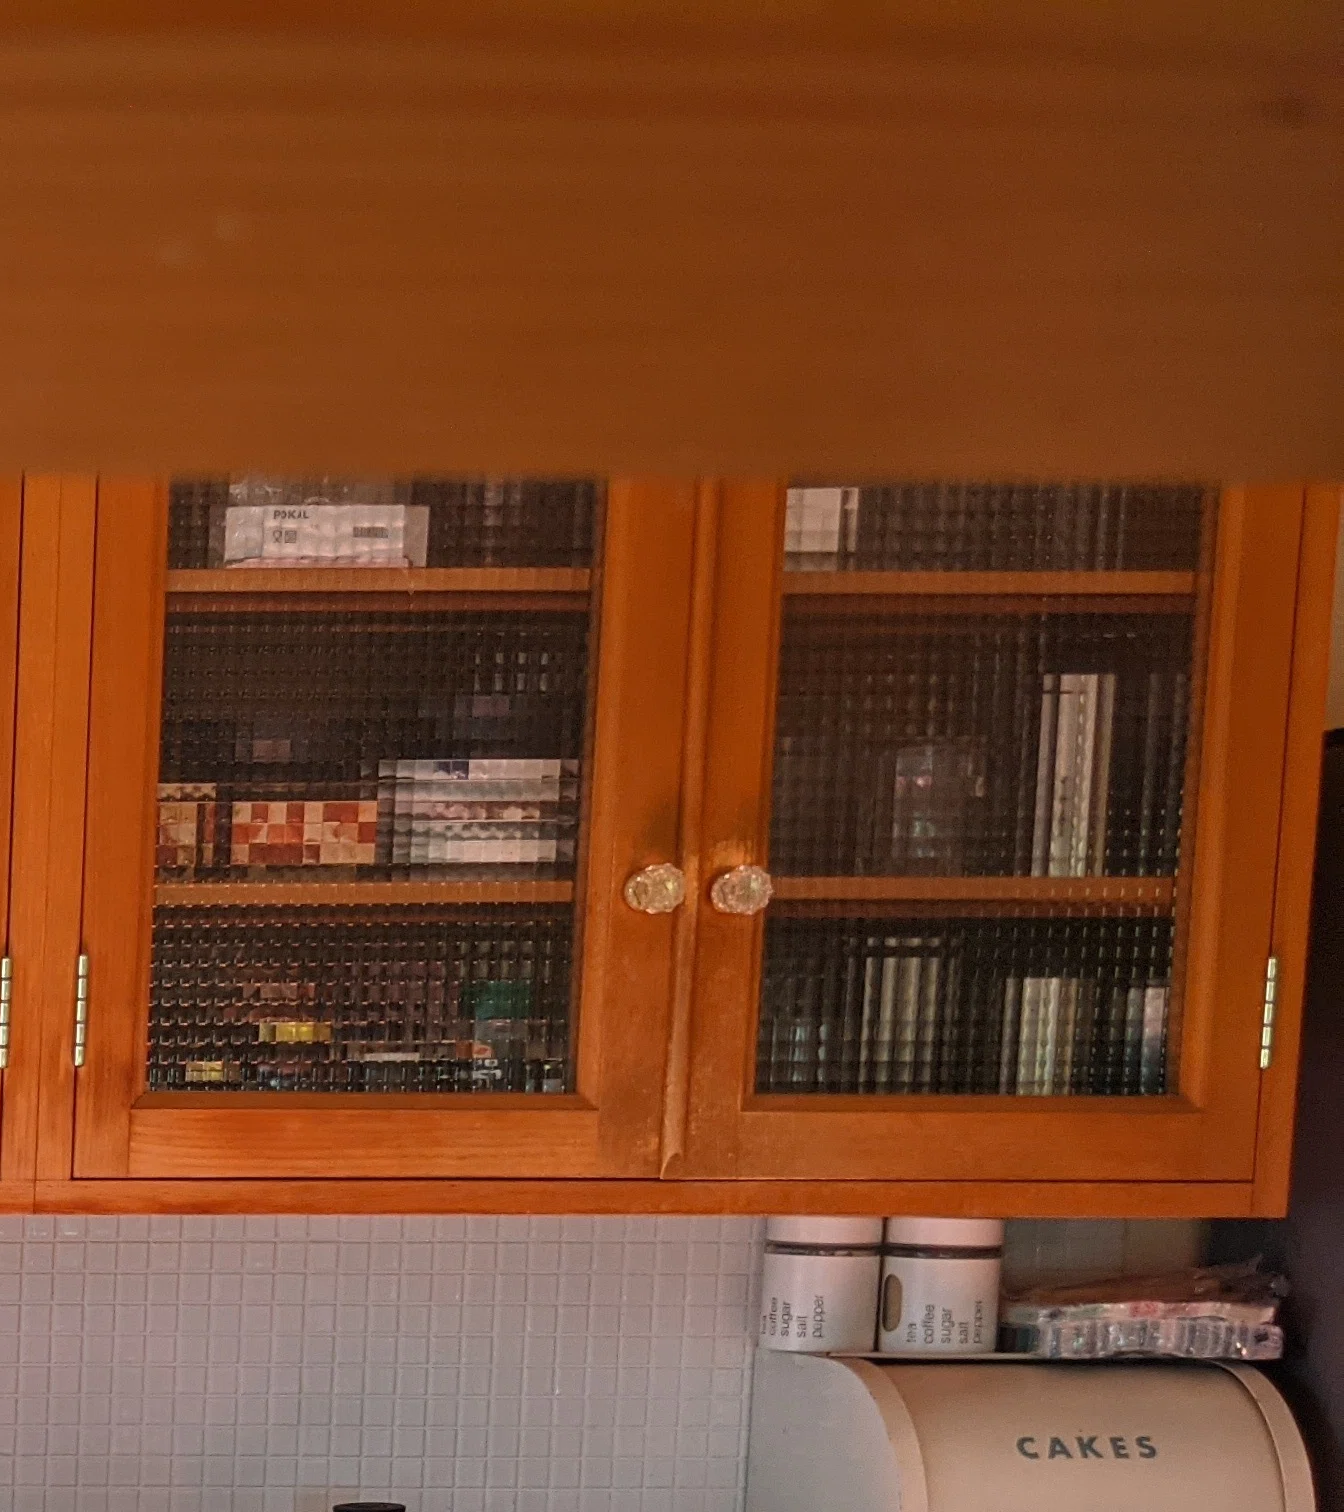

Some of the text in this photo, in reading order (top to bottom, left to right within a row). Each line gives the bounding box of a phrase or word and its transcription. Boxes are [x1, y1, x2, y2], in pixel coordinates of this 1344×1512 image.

[769, 1297, 778, 1336] coffee
[781, 1301, 793, 1338] sugar
[796, 1315, 808, 1338] salt
[813, 1294, 826, 1339] pepper
[921, 1304, 935, 1344] coffee
[941, 1306, 955, 1344] sugar
[958, 1321, 969, 1344] salt
[1016, 1436, 1158, 1460] CAKES
